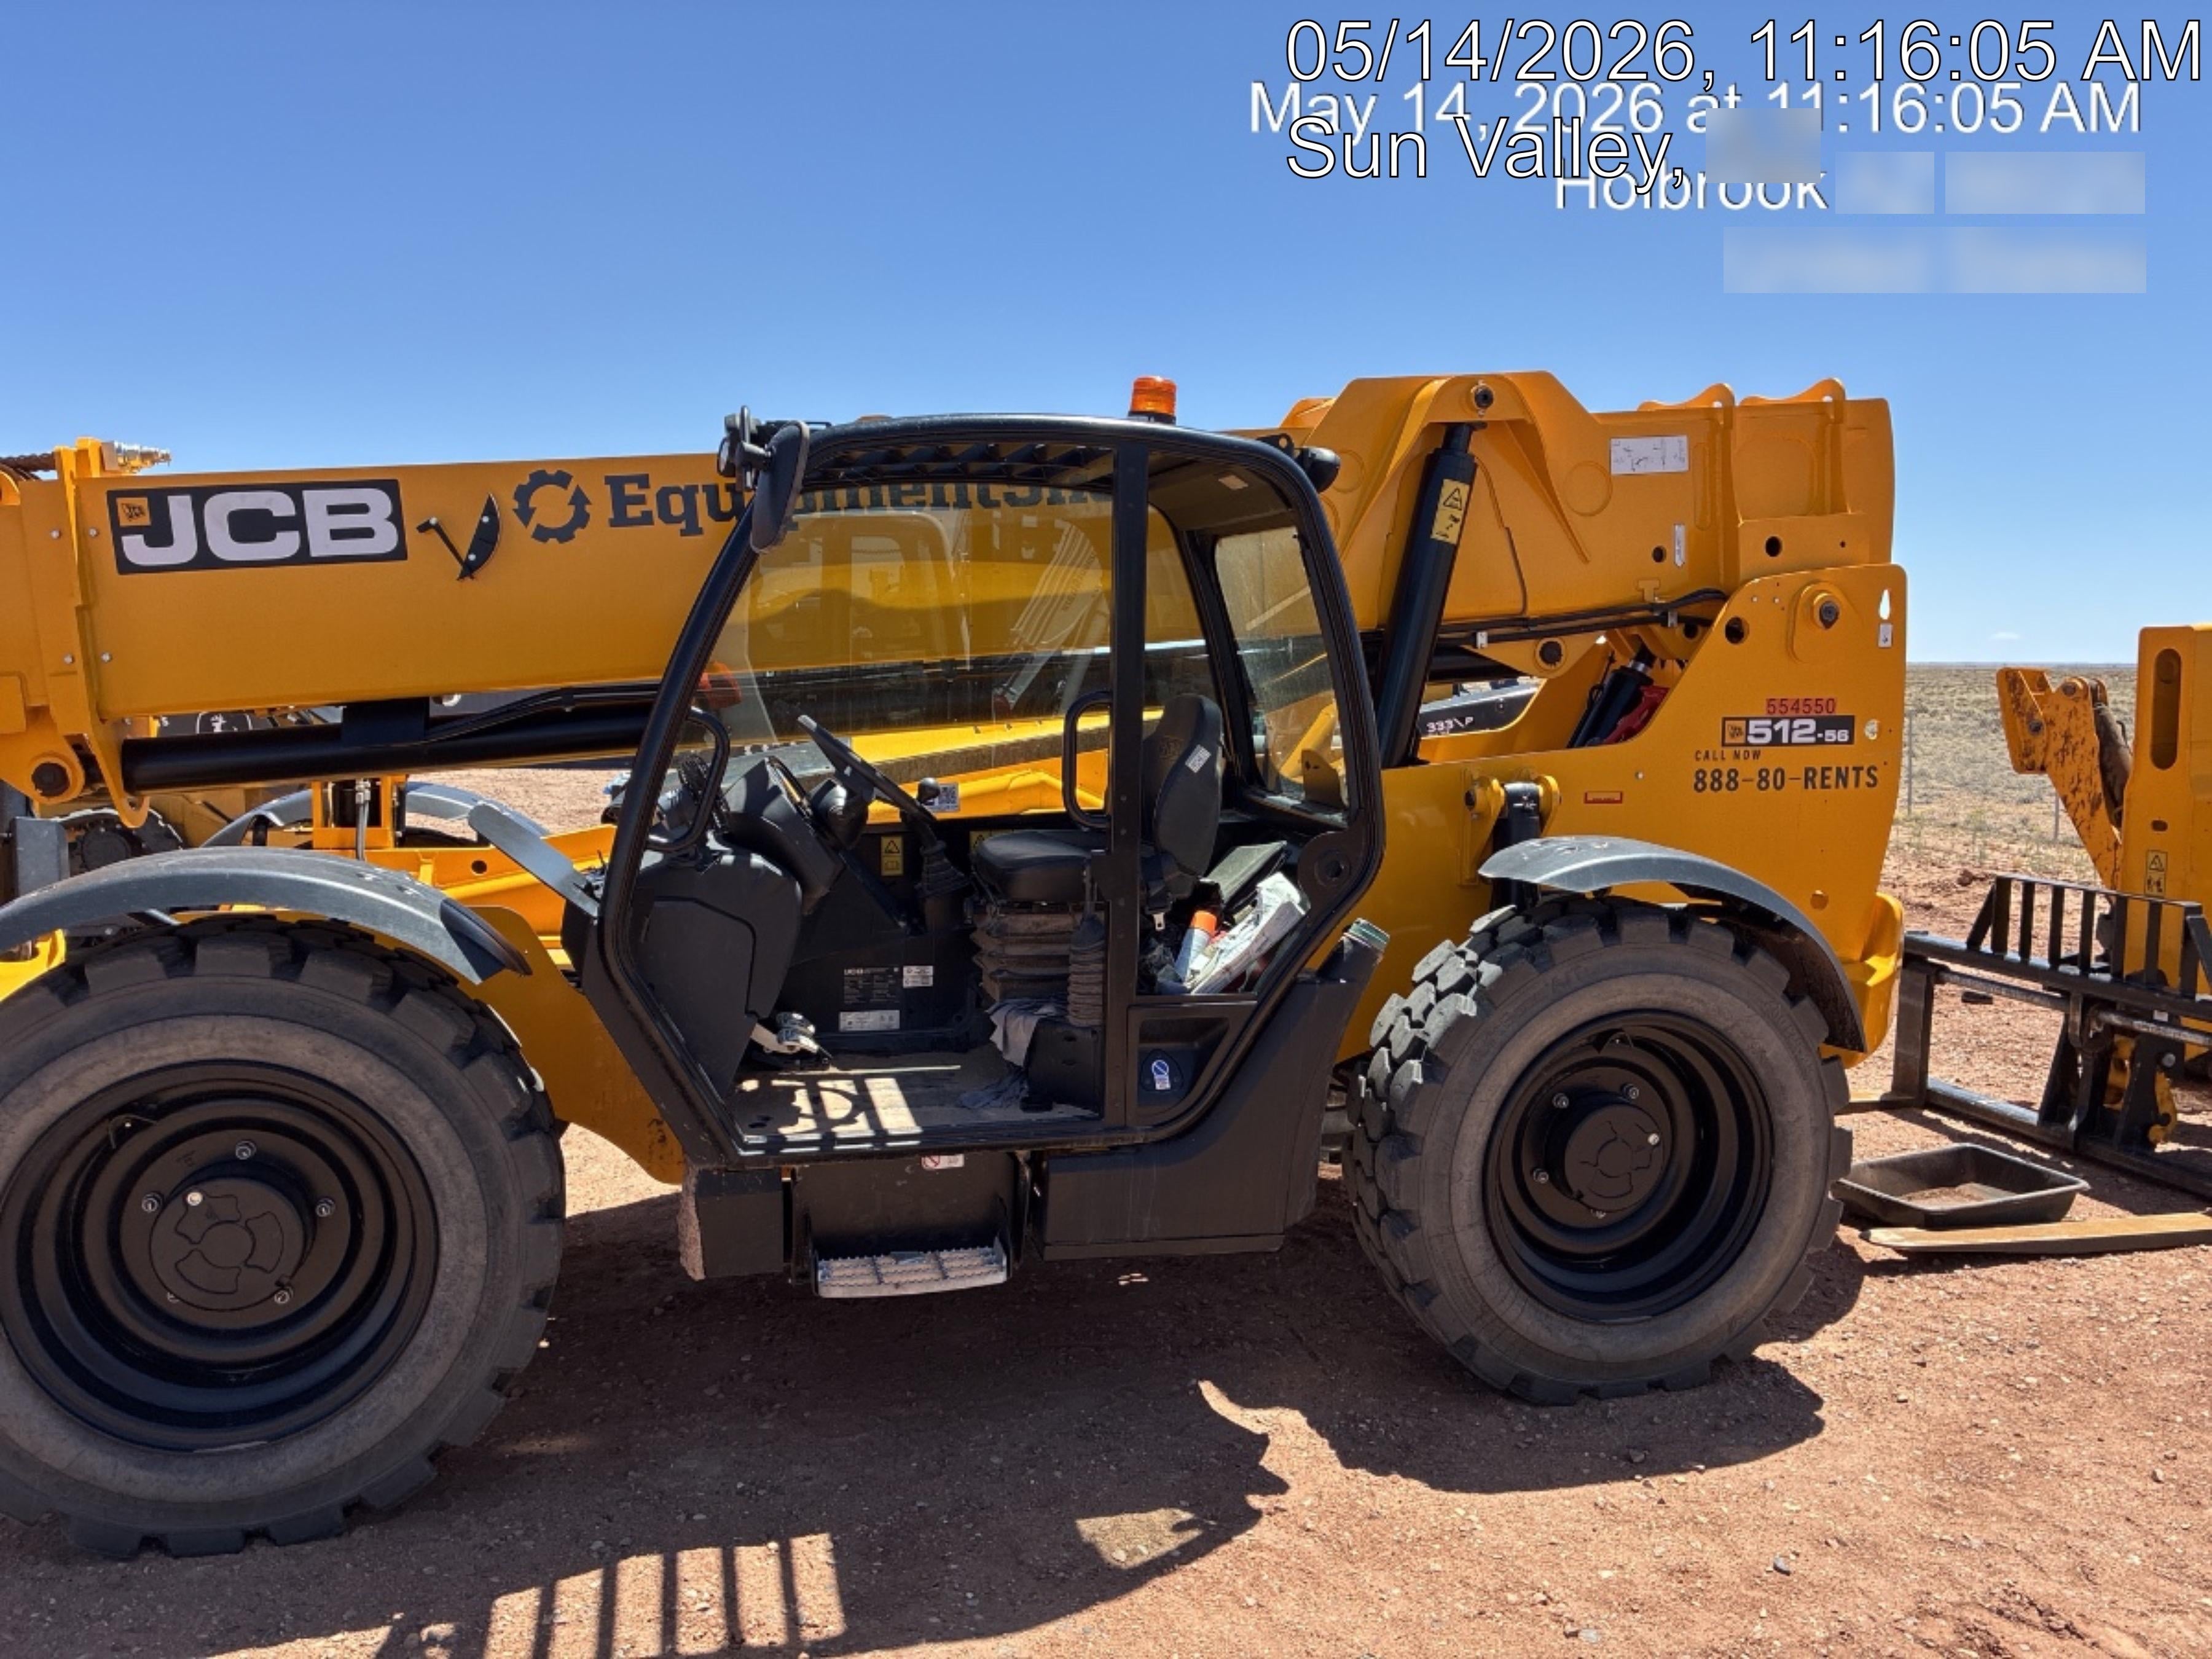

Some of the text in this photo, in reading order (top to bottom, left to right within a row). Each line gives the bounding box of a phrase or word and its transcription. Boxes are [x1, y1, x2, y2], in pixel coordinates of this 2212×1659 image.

[121, 488, 399, 567] JCB
[1767, 697, 1835, 715] 554550
[1746, 718, 1849, 744] 512-56
[1695, 749, 1762, 761] CALL NOW
[1693, 766, 1878, 793] 888-80-RENTS
